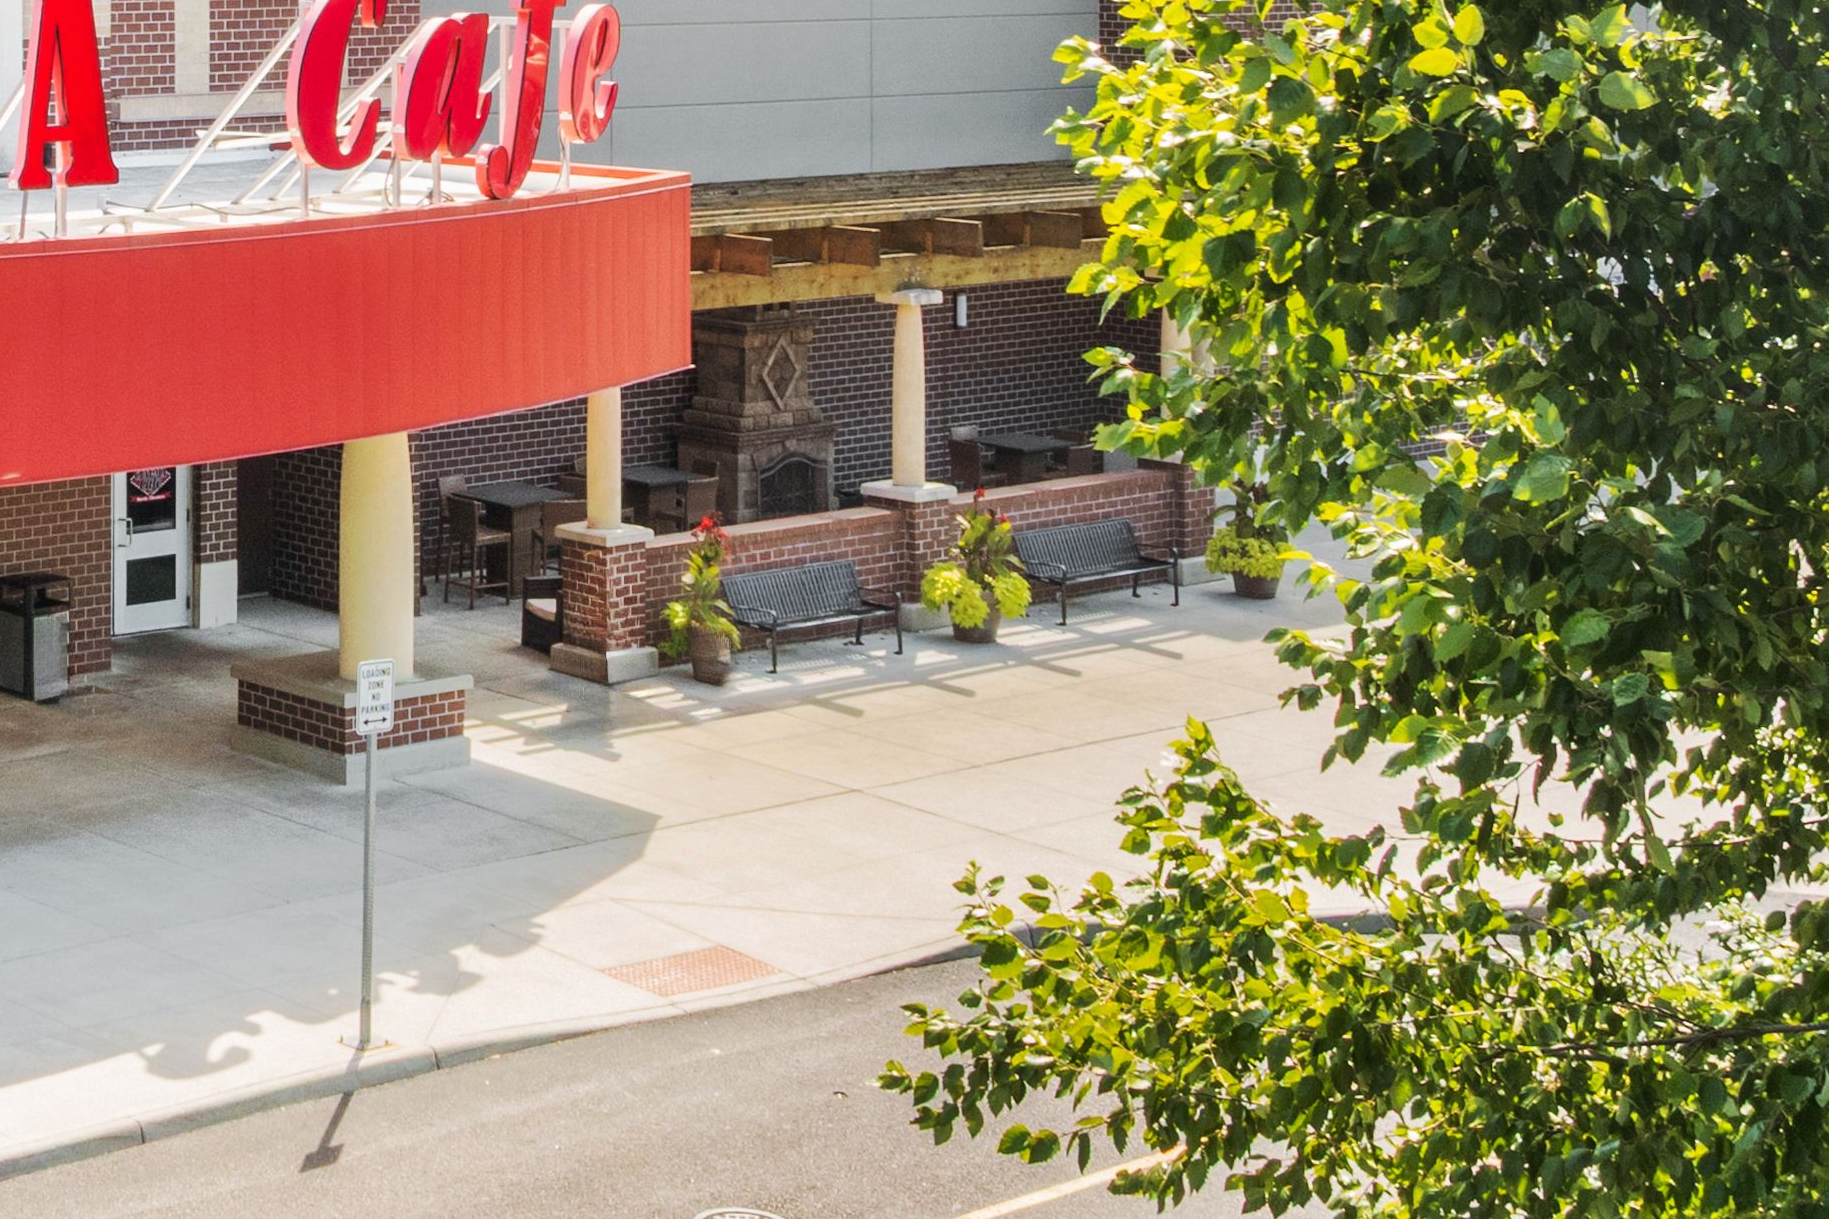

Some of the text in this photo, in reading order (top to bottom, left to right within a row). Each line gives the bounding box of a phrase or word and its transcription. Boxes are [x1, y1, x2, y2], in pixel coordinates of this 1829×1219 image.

[362, 667, 390, 679] LOADING
[368, 680, 385, 690] ZONE
[371, 692, 381, 701] NO
[361, 704, 389, 714] PARKING
